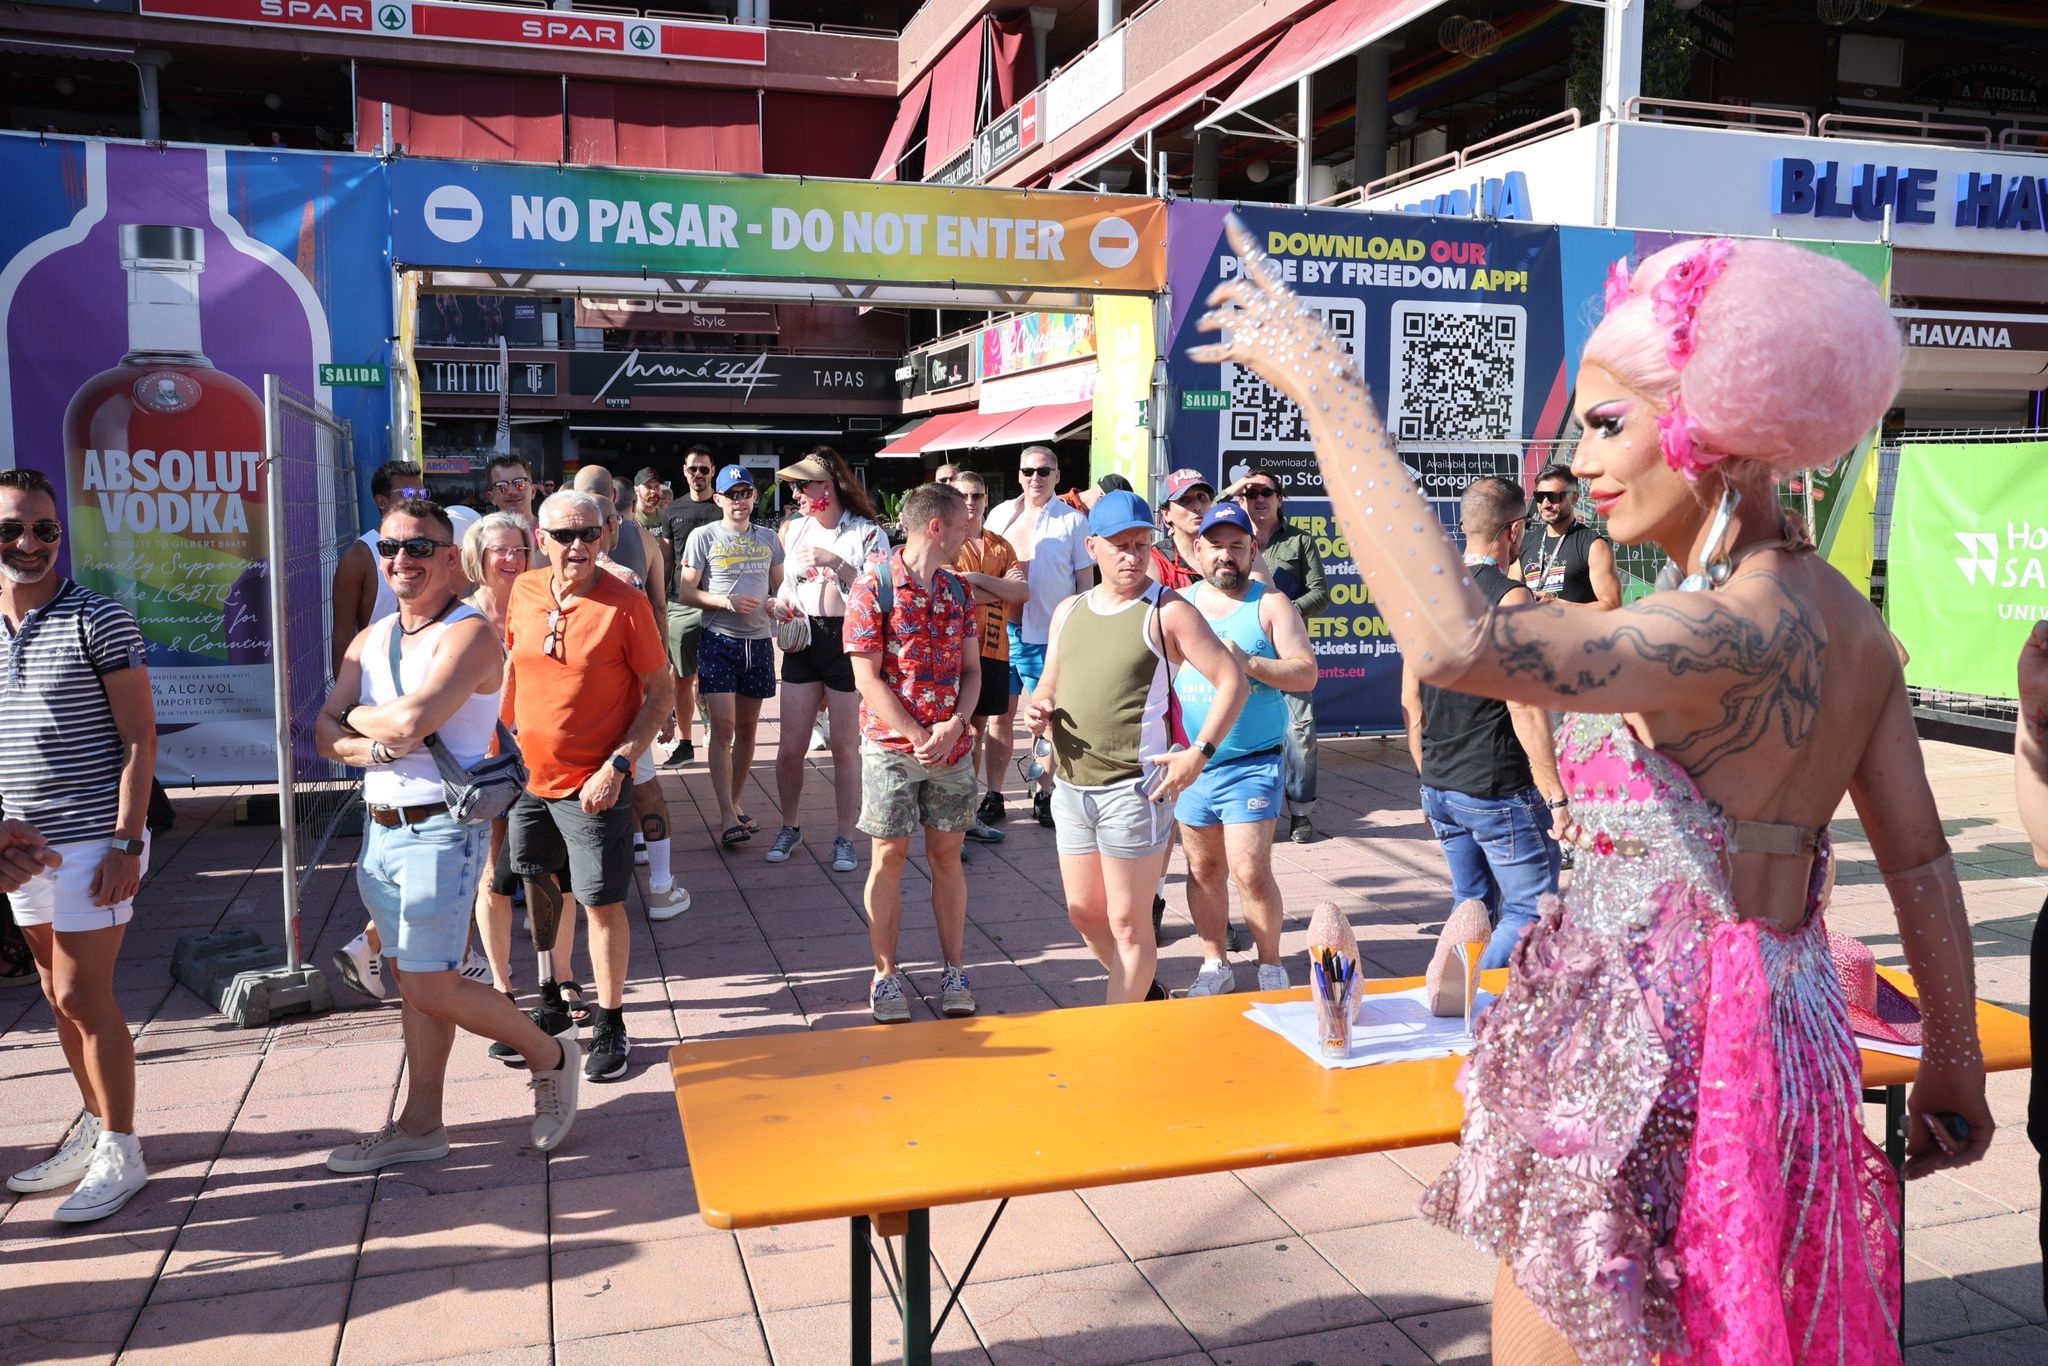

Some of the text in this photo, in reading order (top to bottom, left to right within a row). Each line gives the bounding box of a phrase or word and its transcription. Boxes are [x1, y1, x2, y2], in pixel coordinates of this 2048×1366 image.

[261, 0, 363, 24] SPAR
[522, 20, 616, 44] SPAR
[1771, 157, 1938, 224] BLUE
[511, 195, 579, 243] NO
[589, 199, 740, 248] PASAR
[771, 207, 834, 252] DO
[843, 211, 928, 256] NOT
[936, 215, 1065, 261] ENTER
[1268, 231, 1487, 265] DOWNLOAD OUR
[1219, 255, 1528, 293] PRDE BY FREEDOM APP!
[693, 315, 726, 328] Style
[1909, 323, 2012, 349] HAVANA
[325, 368, 380, 382] SALIDA
[813, 370, 864, 388] TAPAS
[1186, 394, 1227, 407] SALIDA
[83, 449, 260, 492] ABSOLUT
[1260, 457, 1307, 467] Download
[1426, 459, 1466, 469] Available
[1482, 460, 1495, 469] the
[1296, 472, 1323, 486] Sto
[97, 491, 249, 534] VODKA
[172, 540, 216, 548] GILBERT
[218, 540, 248, 548] BAKER
[160, 552, 269, 580] Supporting
[113, 581, 146, 600] the
[228, 603, 258, 635] for
[188, 633, 273, 657] Counting
[1360, 640, 1373, 654] in
[157, 698, 212, 707] IMPORTED
